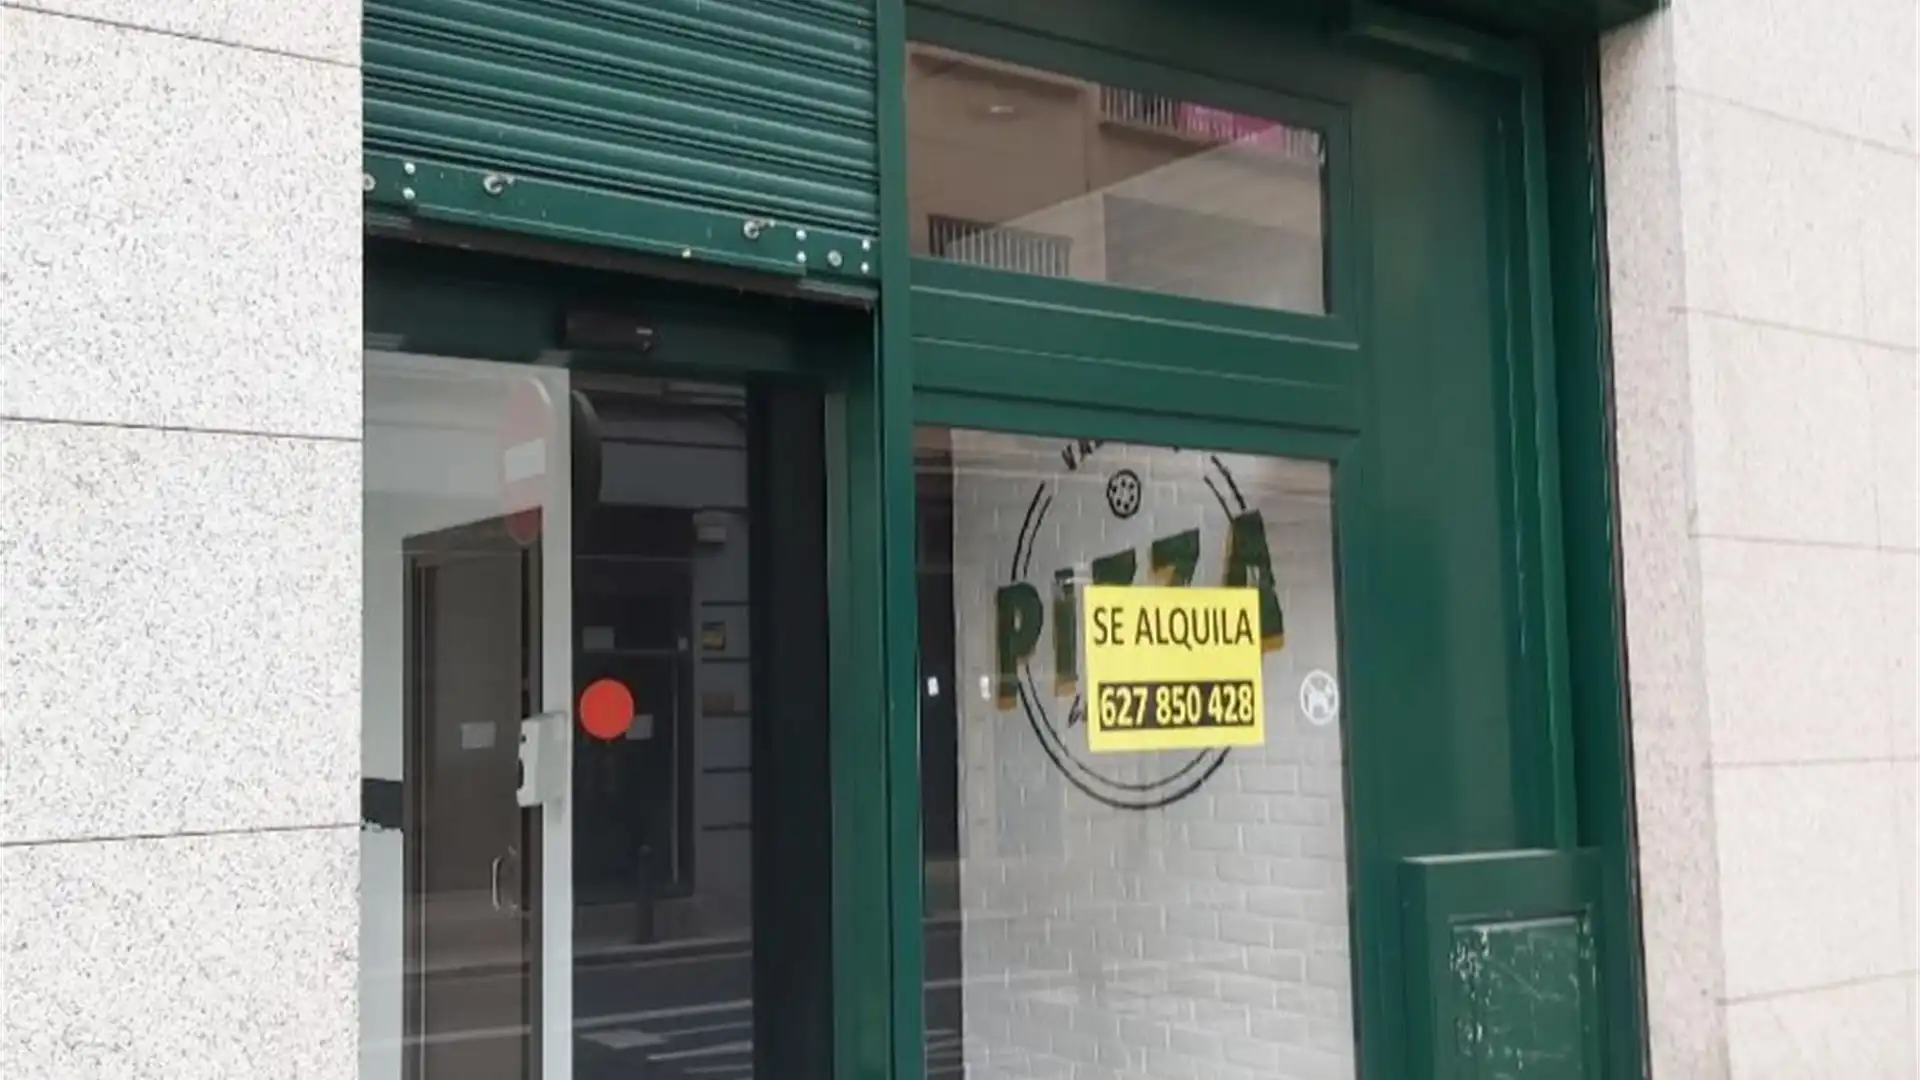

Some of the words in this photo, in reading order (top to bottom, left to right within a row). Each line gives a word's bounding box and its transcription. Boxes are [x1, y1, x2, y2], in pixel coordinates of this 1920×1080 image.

[1093, 607, 1125, 646] SE
[1135, 607, 1254, 651] ALQUILA
[1101, 686, 1148, 727] 627
[1156, 685, 1201, 725] 850
[1208, 683, 1253, 723] 428
